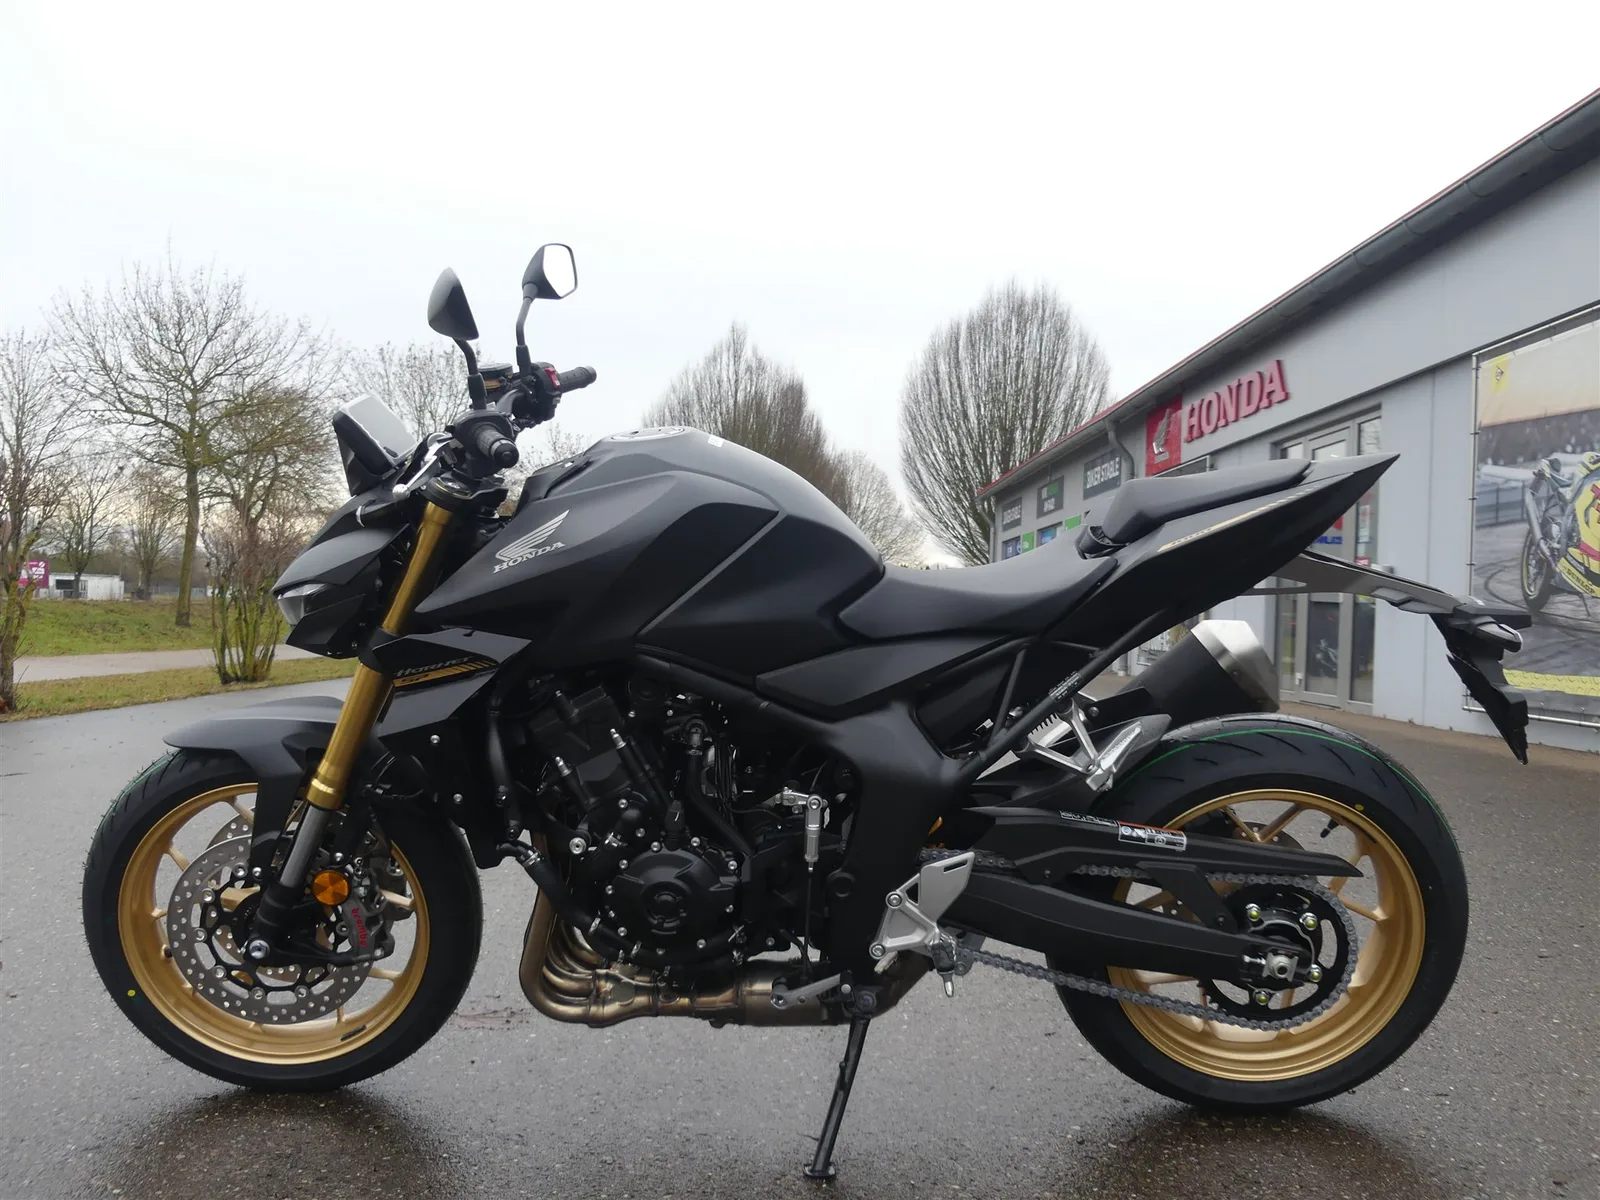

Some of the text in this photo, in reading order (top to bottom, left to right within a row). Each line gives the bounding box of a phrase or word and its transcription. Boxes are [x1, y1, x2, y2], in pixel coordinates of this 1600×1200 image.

[1183, 359, 1291, 443] HONDA
[493, 541, 566, 574] HONDA
[1566, 567, 1596, 595] DUNLOP
[351, 907, 369, 948] brembo
